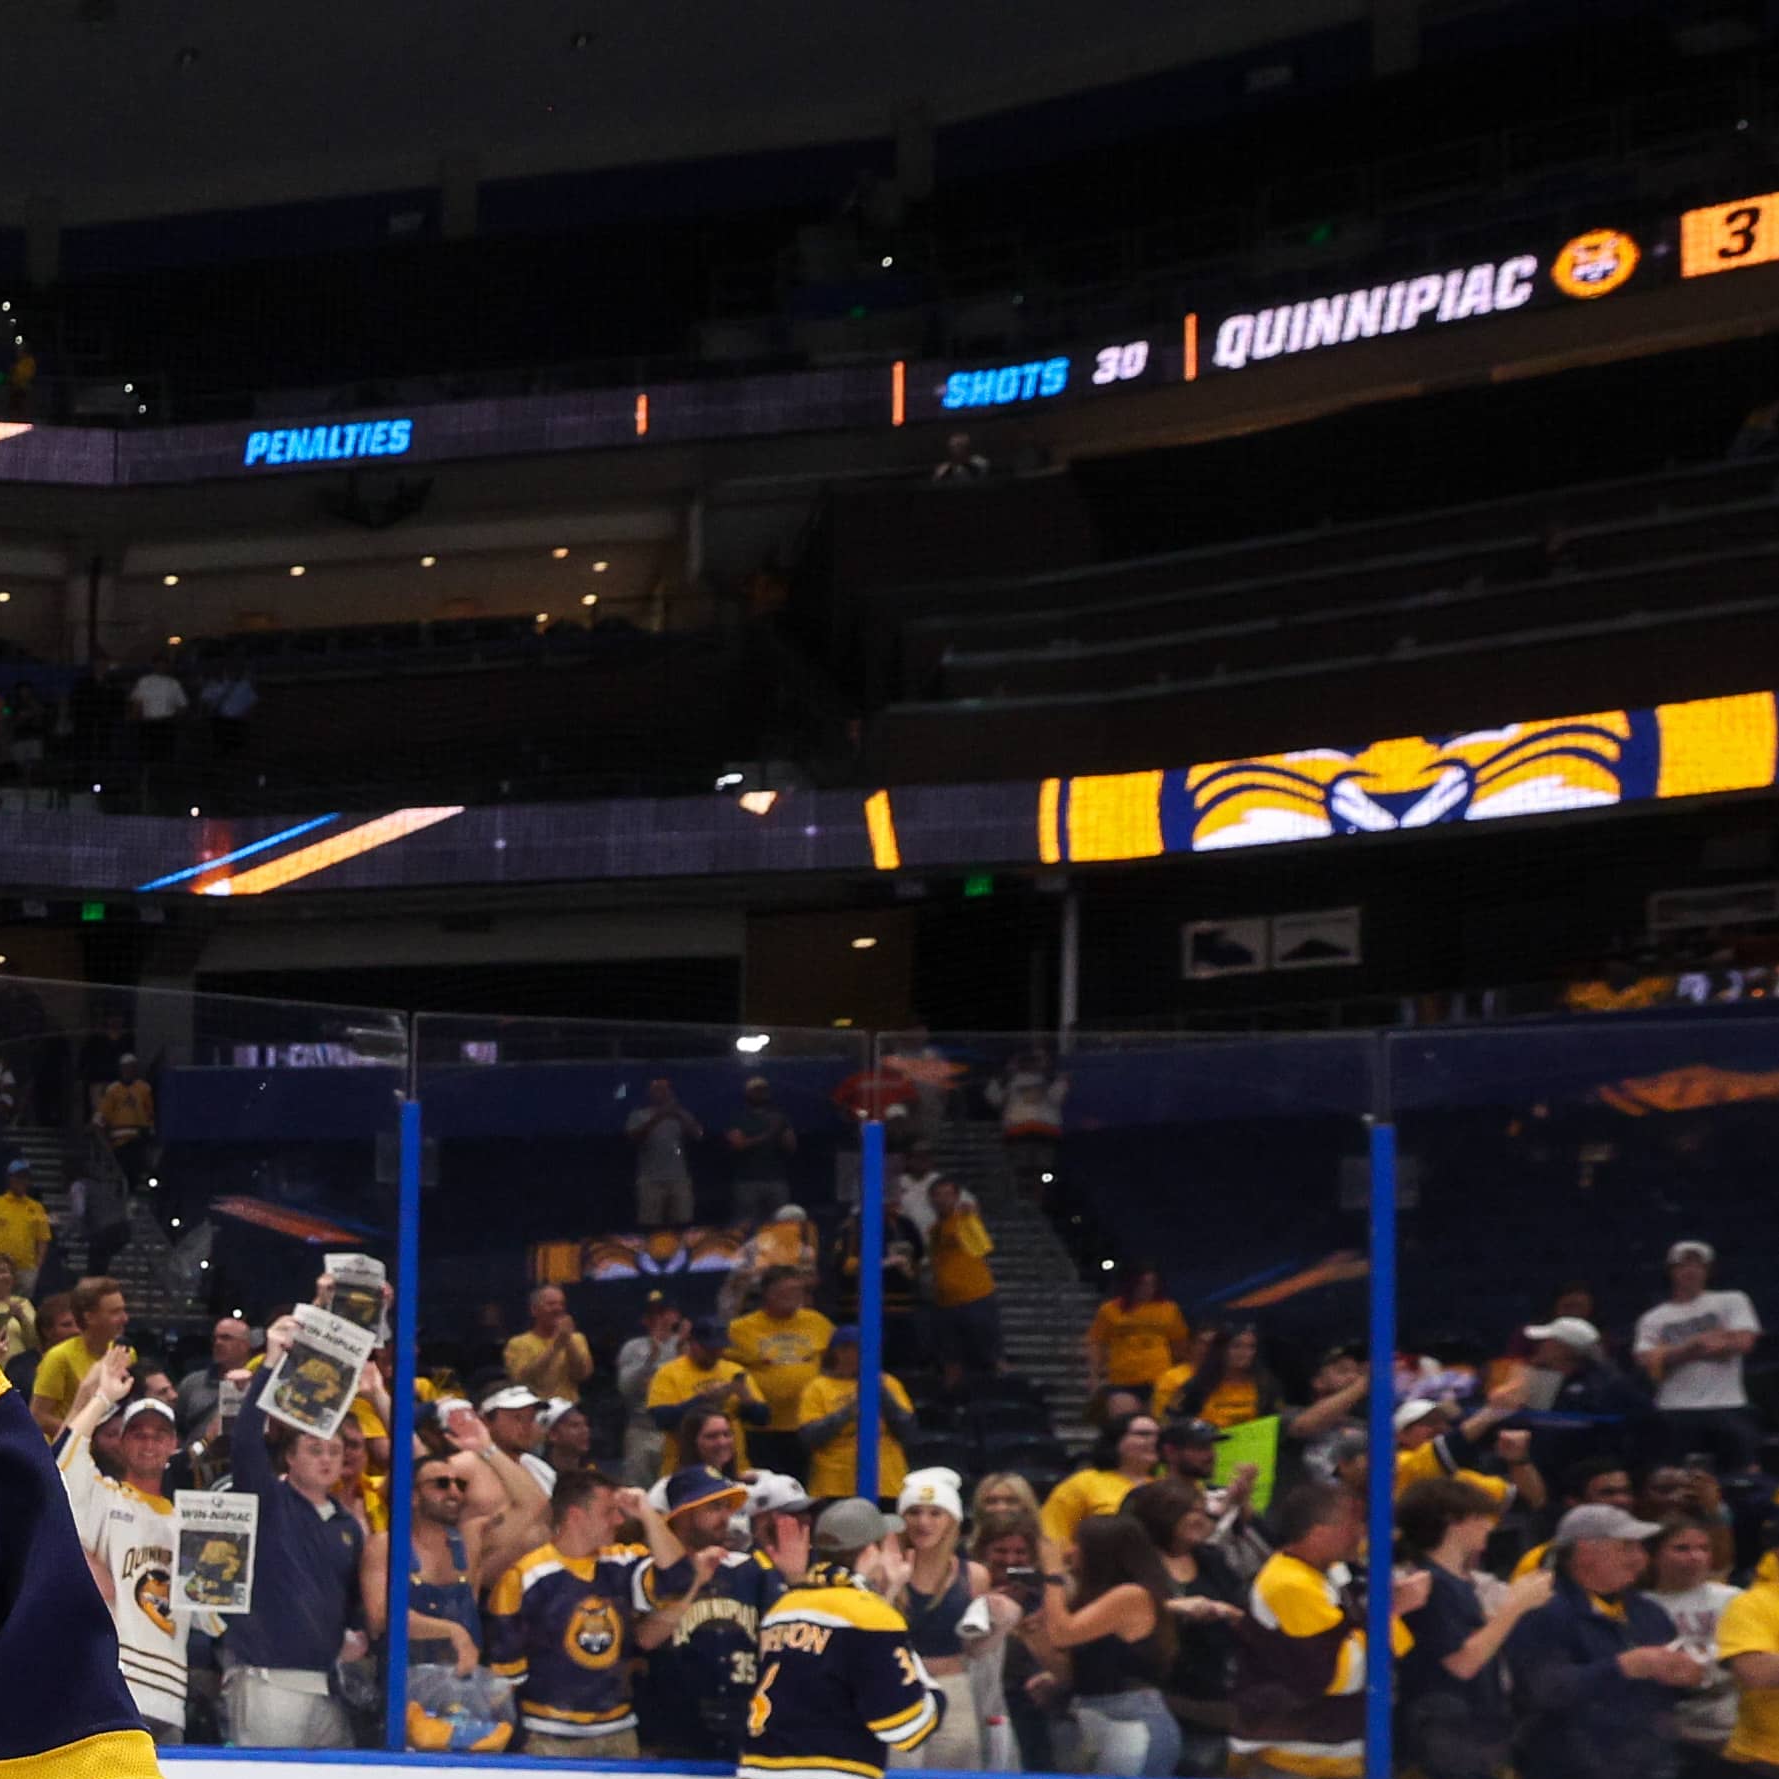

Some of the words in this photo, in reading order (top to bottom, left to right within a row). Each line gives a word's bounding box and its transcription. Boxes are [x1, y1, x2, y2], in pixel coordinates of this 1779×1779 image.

[1716, 206, 1761, 260] 3
[1212, 254, 1539, 371] QUINNIPIAC
[943, 355, 1069, 409] SHOTS
[1091, 340, 1149, 386] 30
[244, 419, 413, 466] PENALTIES
[730, 1650, 758, 1684] 35
